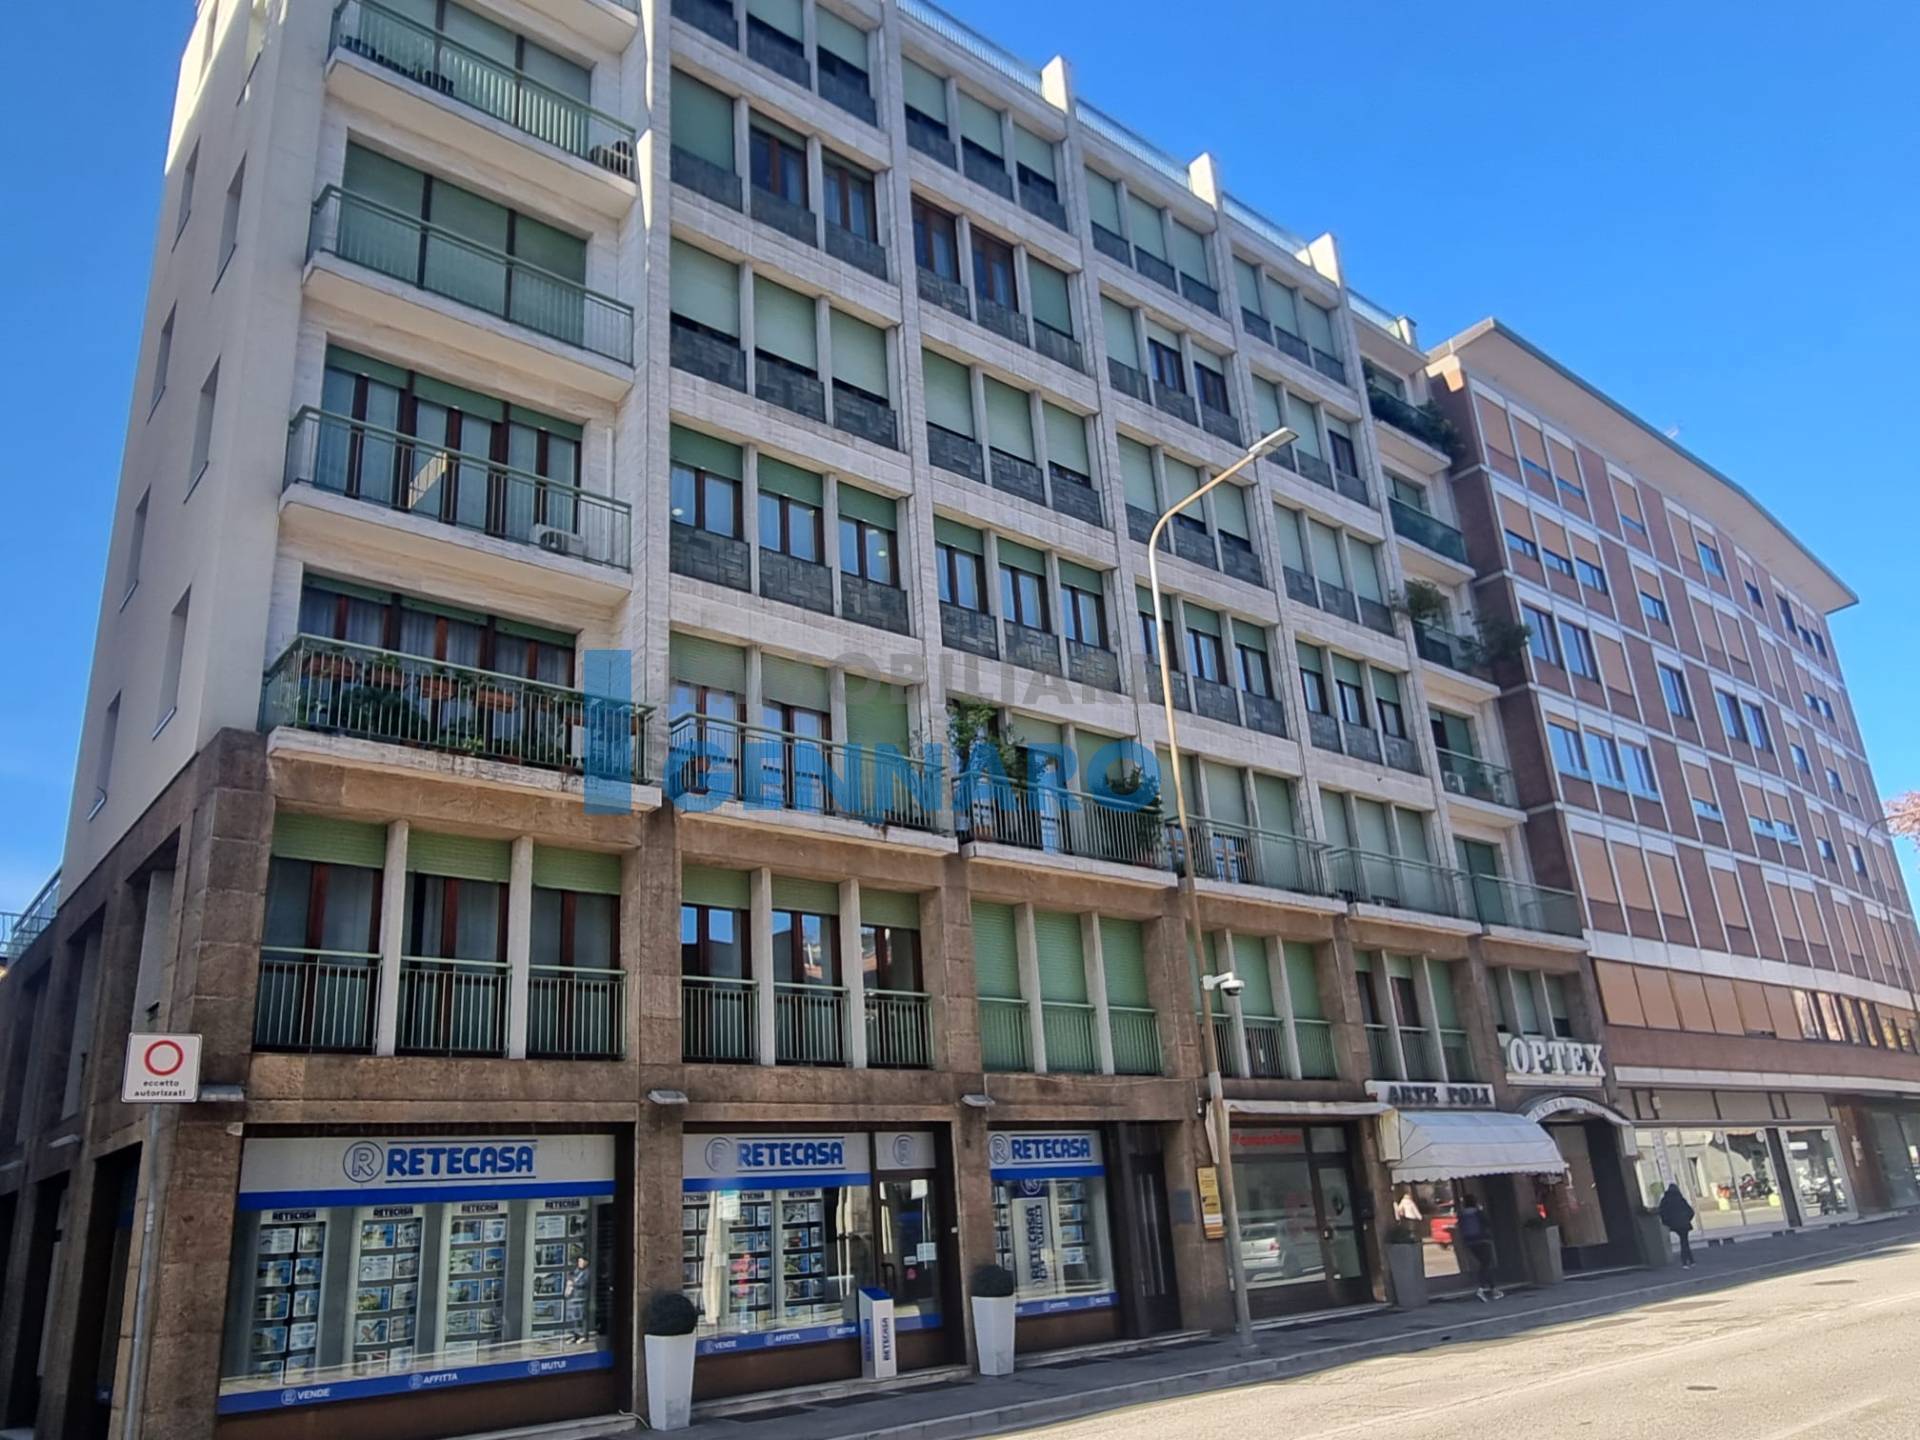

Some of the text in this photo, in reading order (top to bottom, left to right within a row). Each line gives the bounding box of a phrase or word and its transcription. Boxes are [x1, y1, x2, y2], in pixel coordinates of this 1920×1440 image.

[1509, 1038, 1606, 1077] OPTEX
[134, 1089, 186, 1097] autorizzati
[1446, 1086, 1493, 1105] POLI
[386, 1145, 535, 1177] RETECASA
[736, 1140, 845, 1167] RETECASA
[1011, 1138, 1091, 1160] RETECASA
[297, 1360, 567, 1400] VENDE AFFITTA MUTUI
